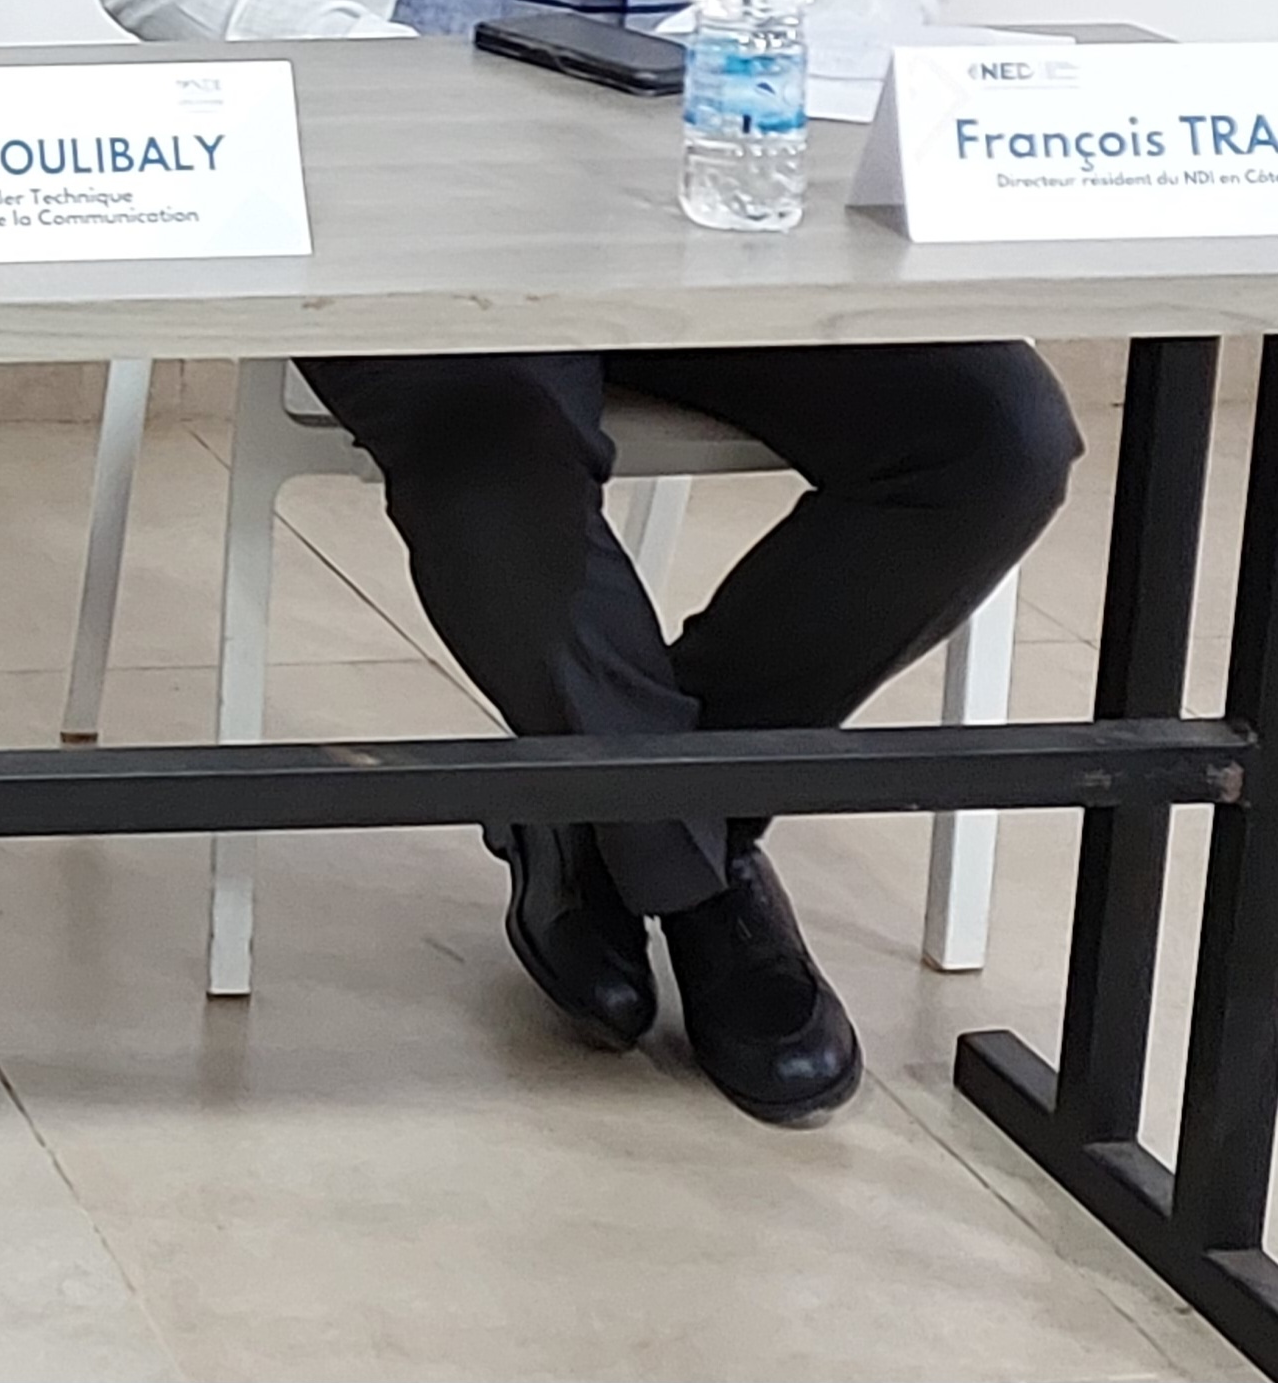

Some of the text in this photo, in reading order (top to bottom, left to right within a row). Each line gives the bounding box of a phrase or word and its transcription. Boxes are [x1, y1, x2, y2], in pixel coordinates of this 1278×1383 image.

[981, 62, 1035, 81] NED
[955, 116, 1166, 172] François
[997, 172, 1077, 189] Directeur
[1081, 169, 1152, 187] résident
[1157, 169, 1180, 185] du
[1184, 169, 1215, 185] NDI
[1219, 173, 1241, 185] en
[29, 187, 134, 208] Technique
[12, 209, 33, 228] la
[37, 205, 201, 227] Communication
